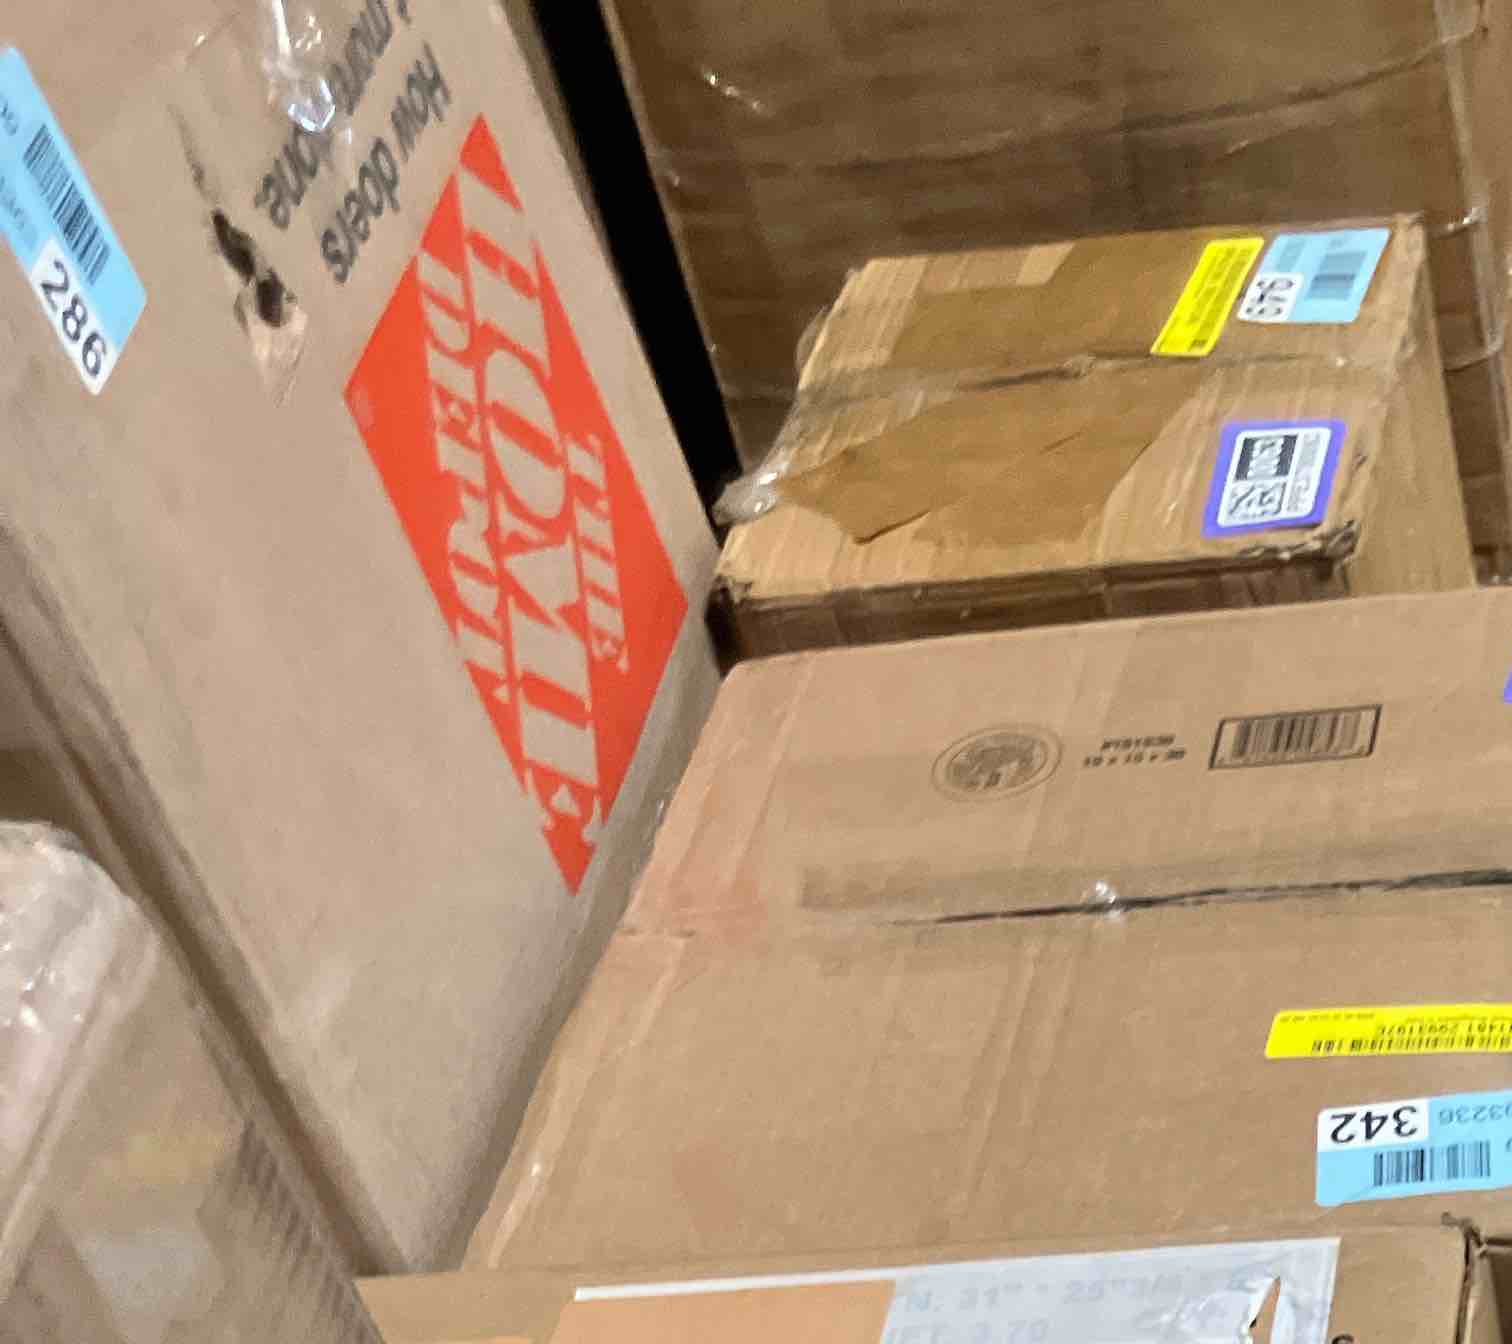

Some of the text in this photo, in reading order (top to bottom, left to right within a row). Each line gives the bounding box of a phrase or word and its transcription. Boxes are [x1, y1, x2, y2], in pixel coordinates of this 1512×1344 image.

[320, 42, 452, 285] How doers
[39, 259, 108, 377] 286
[415, 252, 520, 708] DEPOT
[460, 148, 600, 856] HOME
[566, 430, 630, 676] THE
[1328, 1104, 1418, 1143] 342
